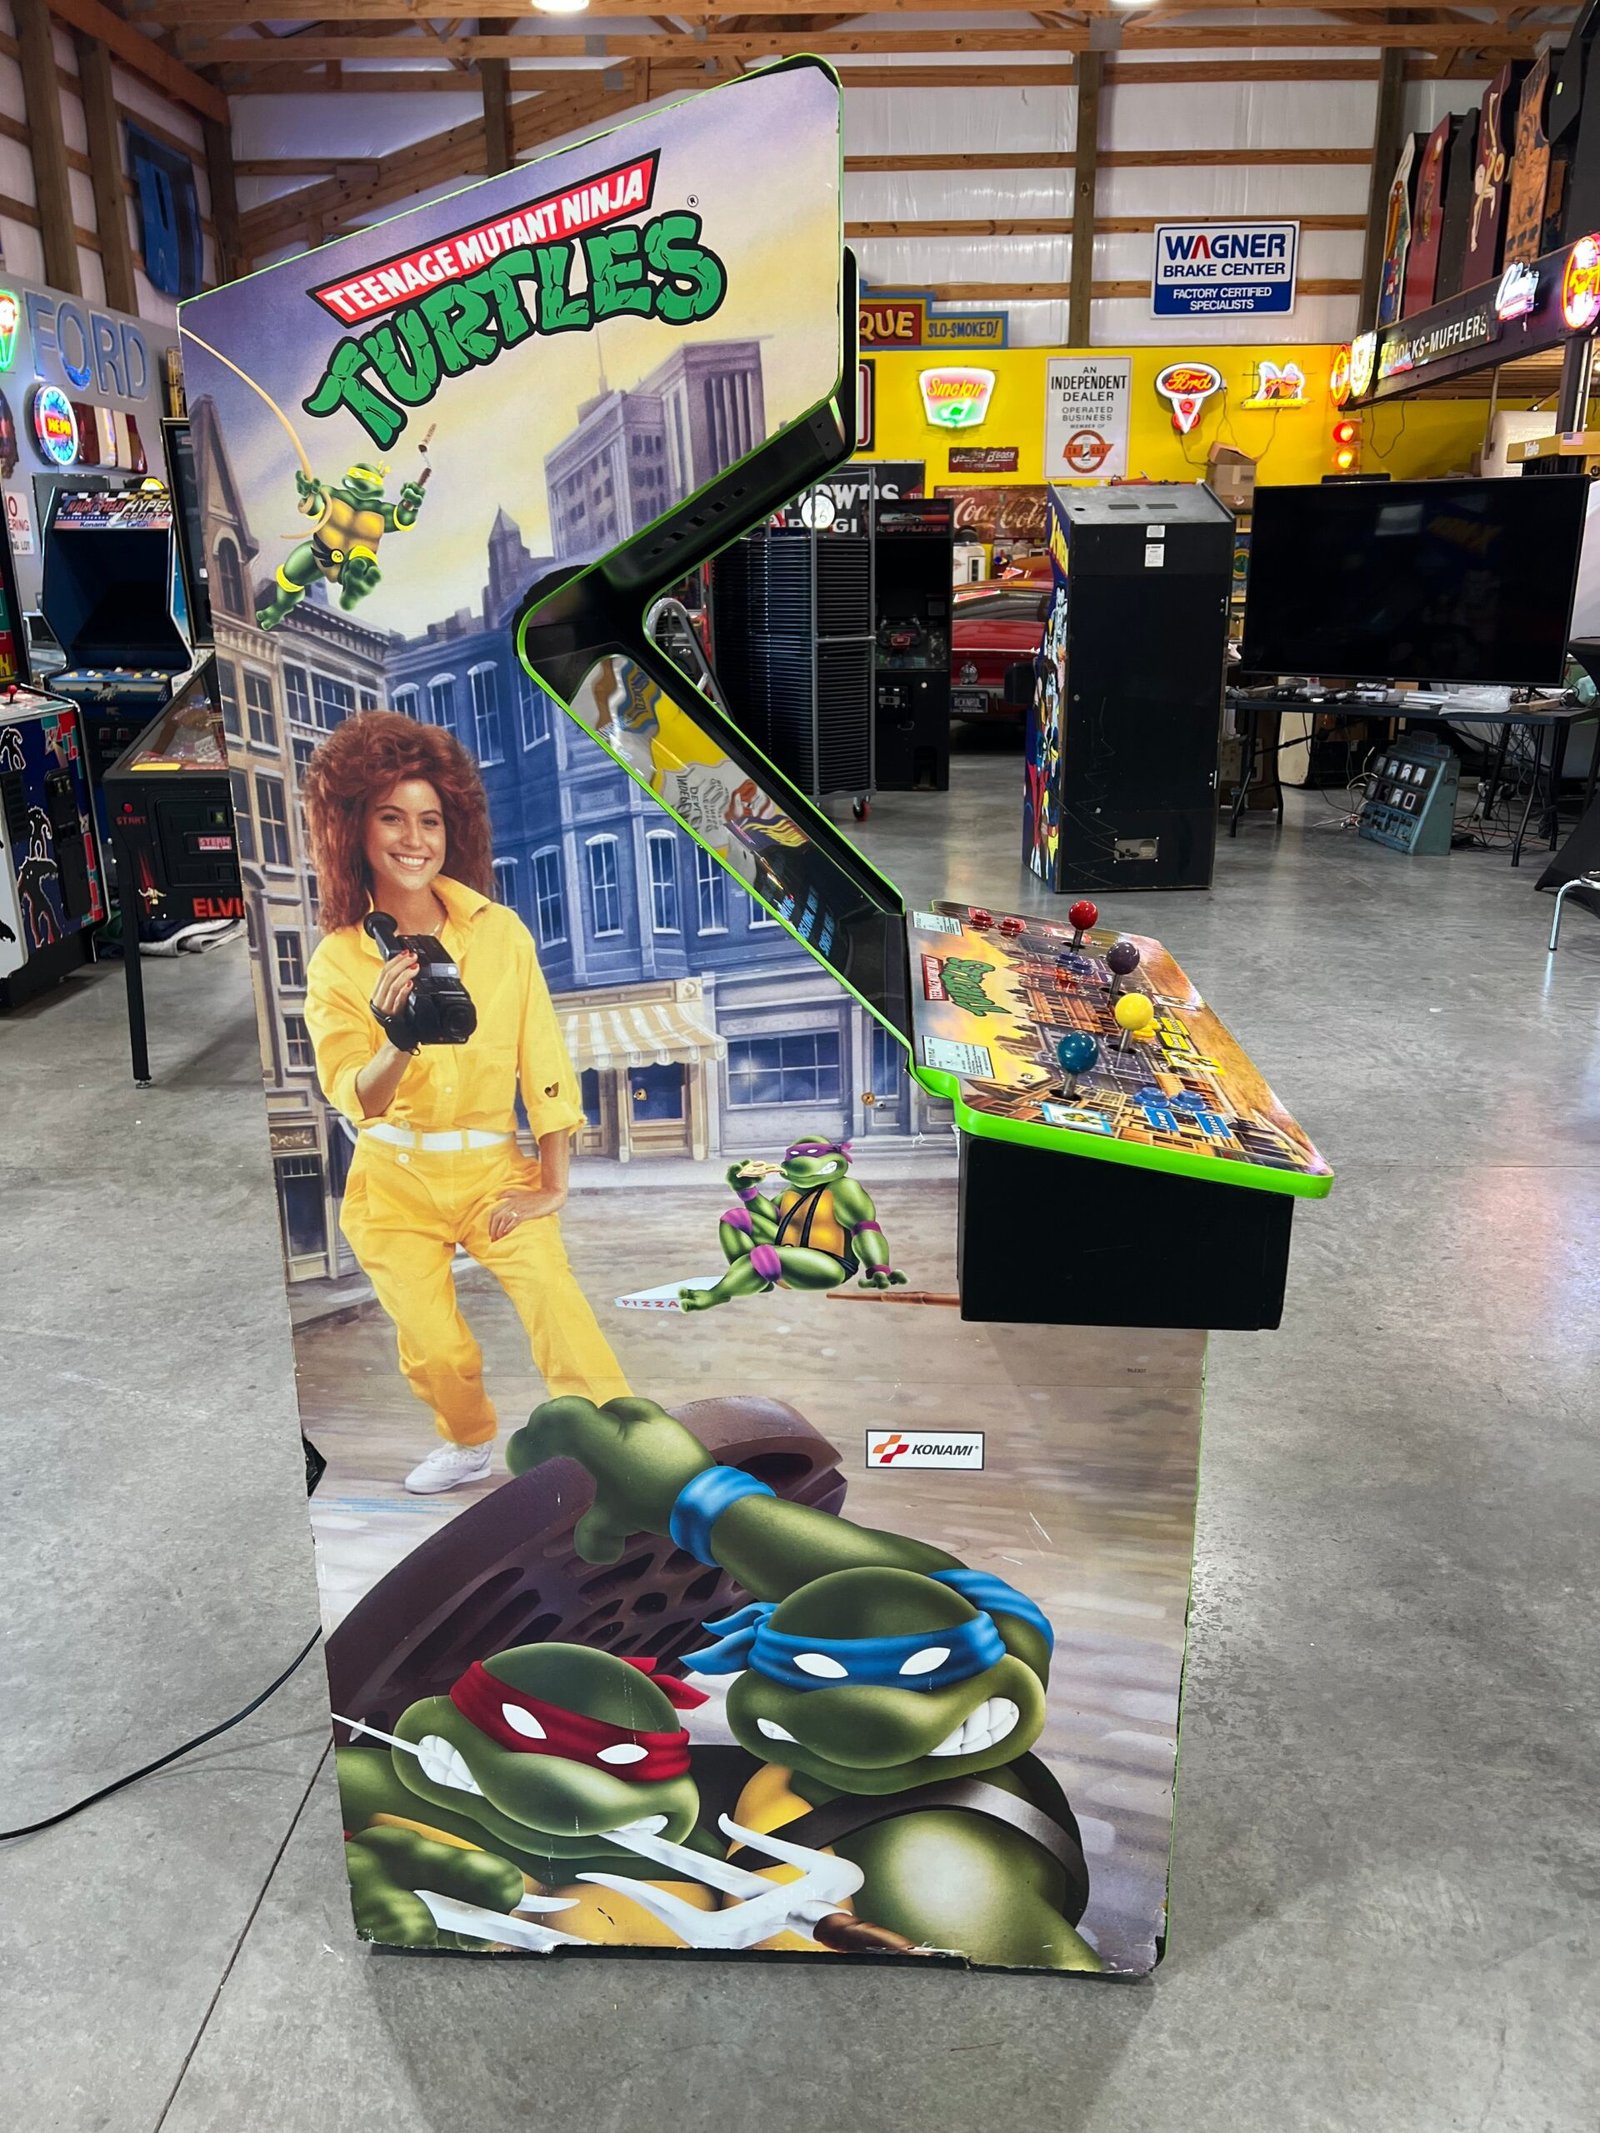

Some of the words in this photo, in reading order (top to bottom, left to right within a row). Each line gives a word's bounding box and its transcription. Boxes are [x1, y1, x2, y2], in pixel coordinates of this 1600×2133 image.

[324, 247, 459, 315] TEENAGE
[460, 209, 560, 269] MUTANT
[562, 168, 644, 229] NINJA
[1165, 233, 1286, 260] WAGNER
[1163, 264, 1217, 277] BRAKE
[1221, 262, 1285, 276] CENTER
[1173, 288, 1218, 299] FACTORY
[1220, 287, 1272, 298] CERTIFIED
[1190, 299, 1254, 311] SPECIALISTS
[303, 210, 727, 450] TURTLES
[928, 320, 999, 338] SLO-SMOKED!
[24, 289, 149, 401] FORD
[1083, 366, 1097, 374] AN
[928, 377, 987, 398] Sinclair
[1051, 375, 1127, 390] INDEPENDENT
[1164, 369, 1212, 391] Ford
[1063, 391, 1114, 402] DEALER
[1062, 406, 1113, 414] OPERATED
[1062, 414, 1113, 422] BUSINESS
[116, 816, 147, 825] START
[193, 897, 244, 918] ELVI
[622, 1299, 679, 1308] PIZZA
[911, 1444, 974, 1456] KONAMI
